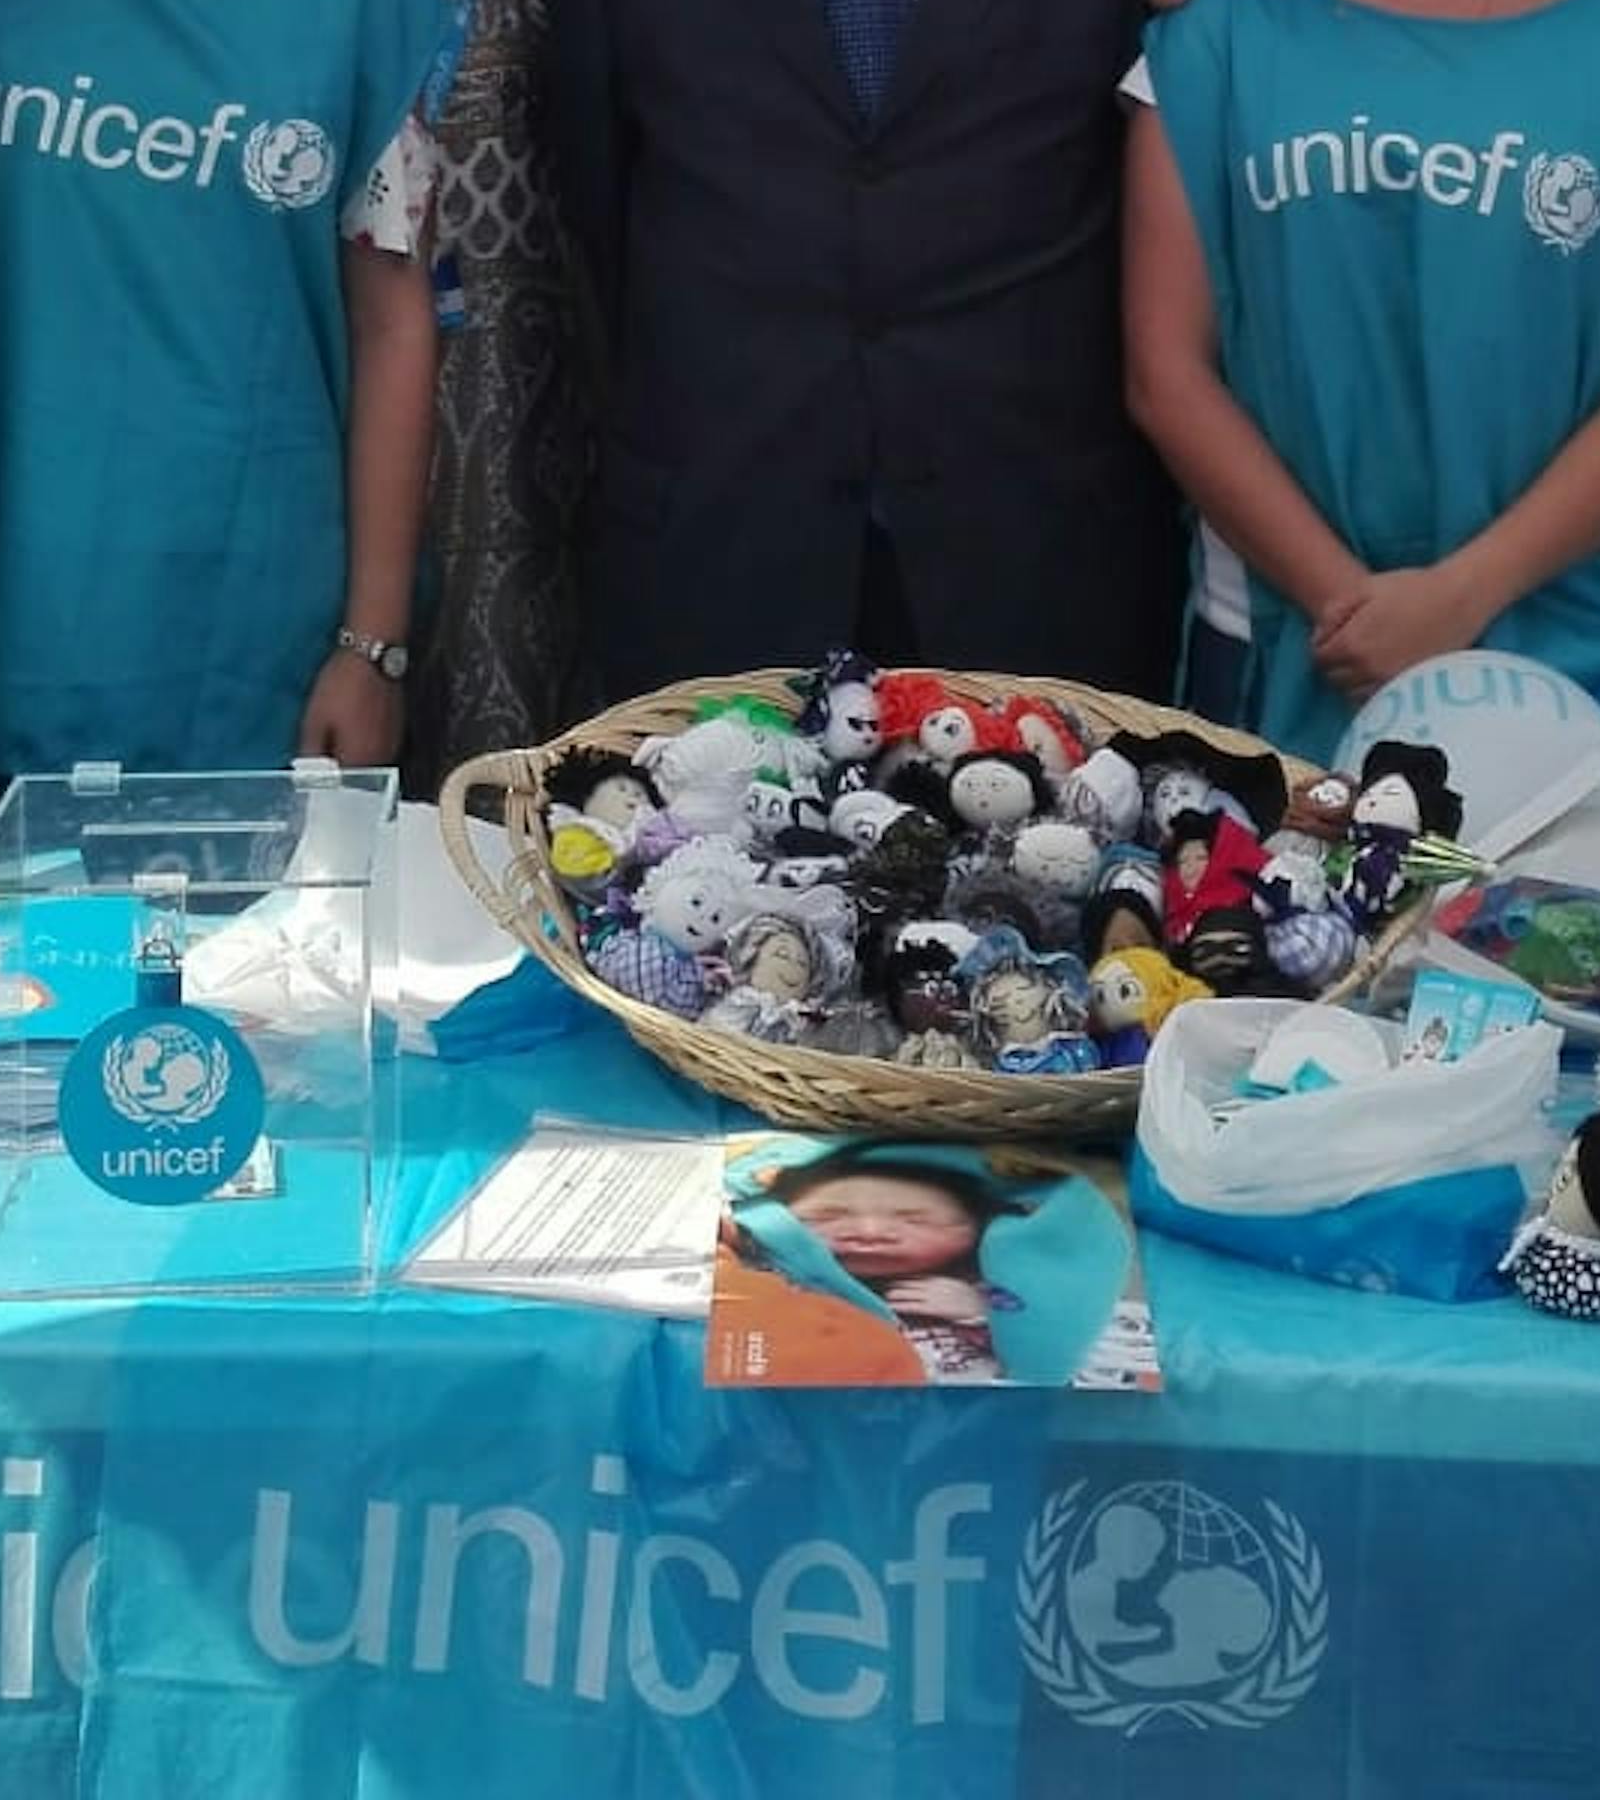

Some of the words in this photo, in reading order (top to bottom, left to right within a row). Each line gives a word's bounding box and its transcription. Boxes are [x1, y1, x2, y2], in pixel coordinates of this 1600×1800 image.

[1246, 114, 1525, 217] unicef
[103, 1136, 226, 1178] unicef
[249, 1453, 994, 1725] unicef
